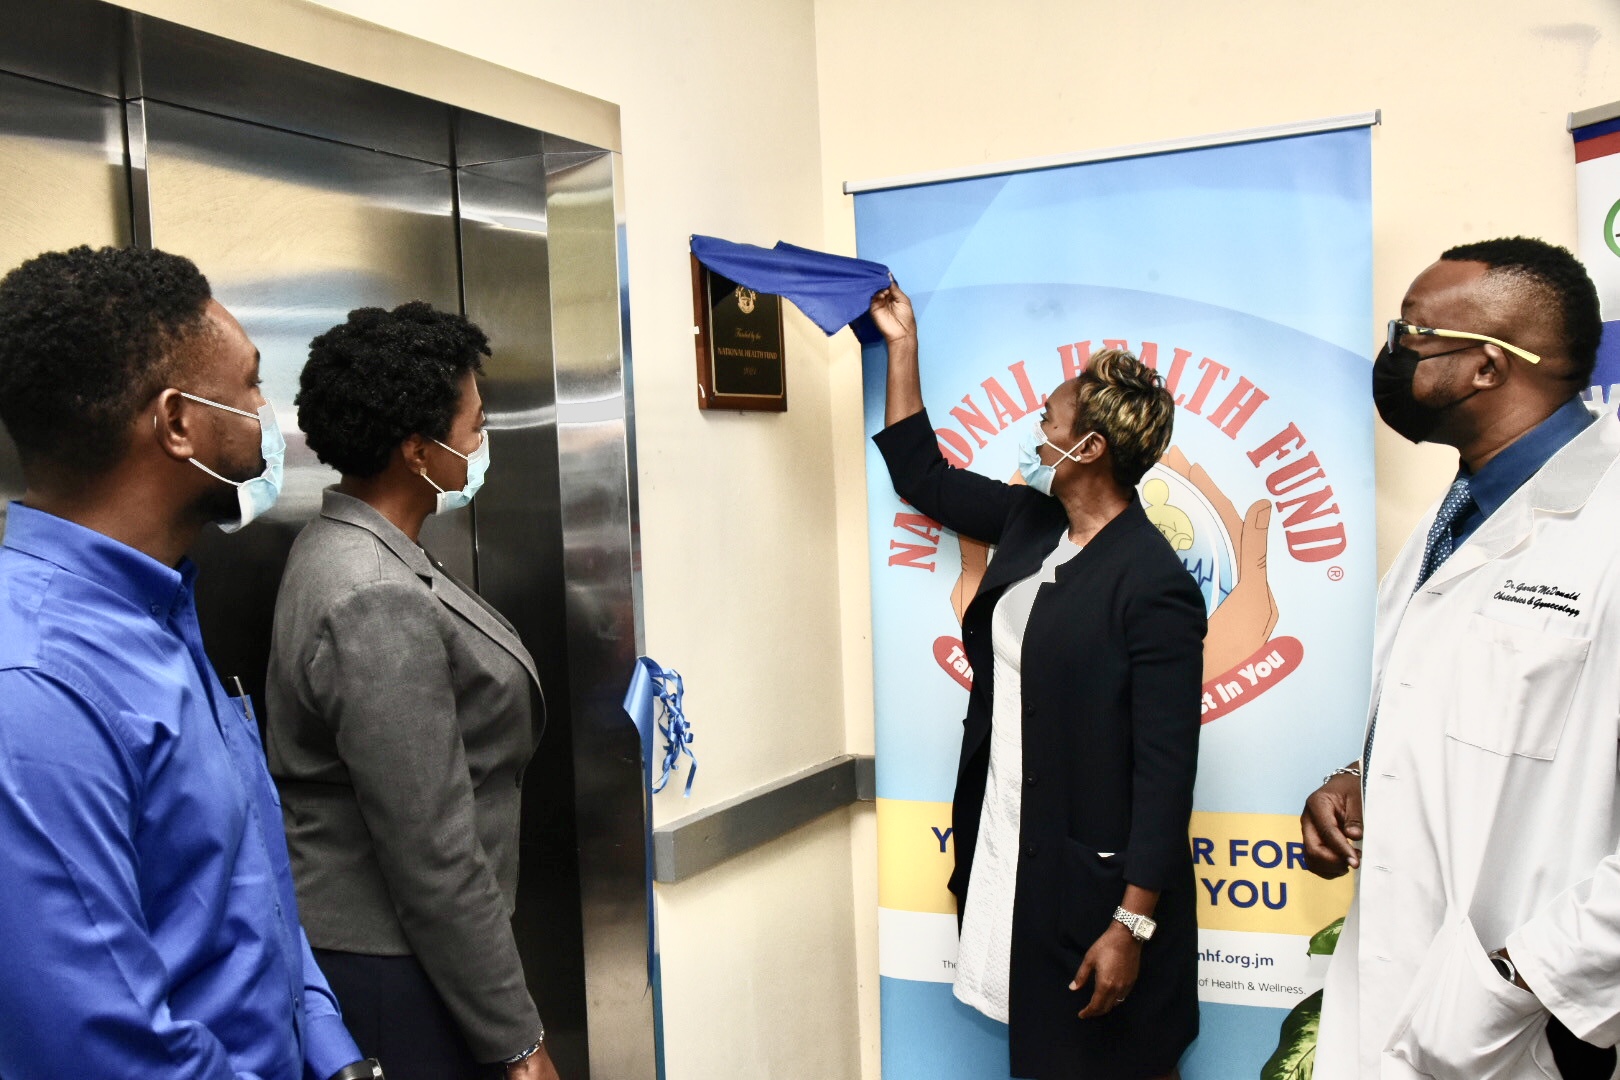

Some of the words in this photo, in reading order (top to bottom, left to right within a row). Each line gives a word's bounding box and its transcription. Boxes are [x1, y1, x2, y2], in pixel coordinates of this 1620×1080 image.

[717, 346, 744, 357] NATIONAL
[744, 349, 764, 359] HEALTH
[763, 351, 778, 360] FUND
[888, 360, 1048, 573] NAONAL
[1057, 339, 1270, 440] HLTH
[1246, 421, 1347, 563] FUND
[1493, 591, 1526, 605] Obstetrics
[1526, 596, 1534, 605] &
[1503, 579, 1515, 590] Dr.
[1514, 583, 1539, 594] Garth
[1537, 584, 1581, 601] McDonald
[1214, 683, 1244, 704] In
[1237, 649, 1286, 687] You
[1192, 837, 1215, 865] R
[1229, 839, 1308, 870] FOR
[1200, 878, 1287, 910] YOU
[1198, 949, 1274, 968] nhf.org.jm
[1199, 978, 1209, 987] of
[1211, 978, 1245, 990] Health
[1247, 981, 1256, 991] &
[1258, 982, 1307, 995] Wellness.
